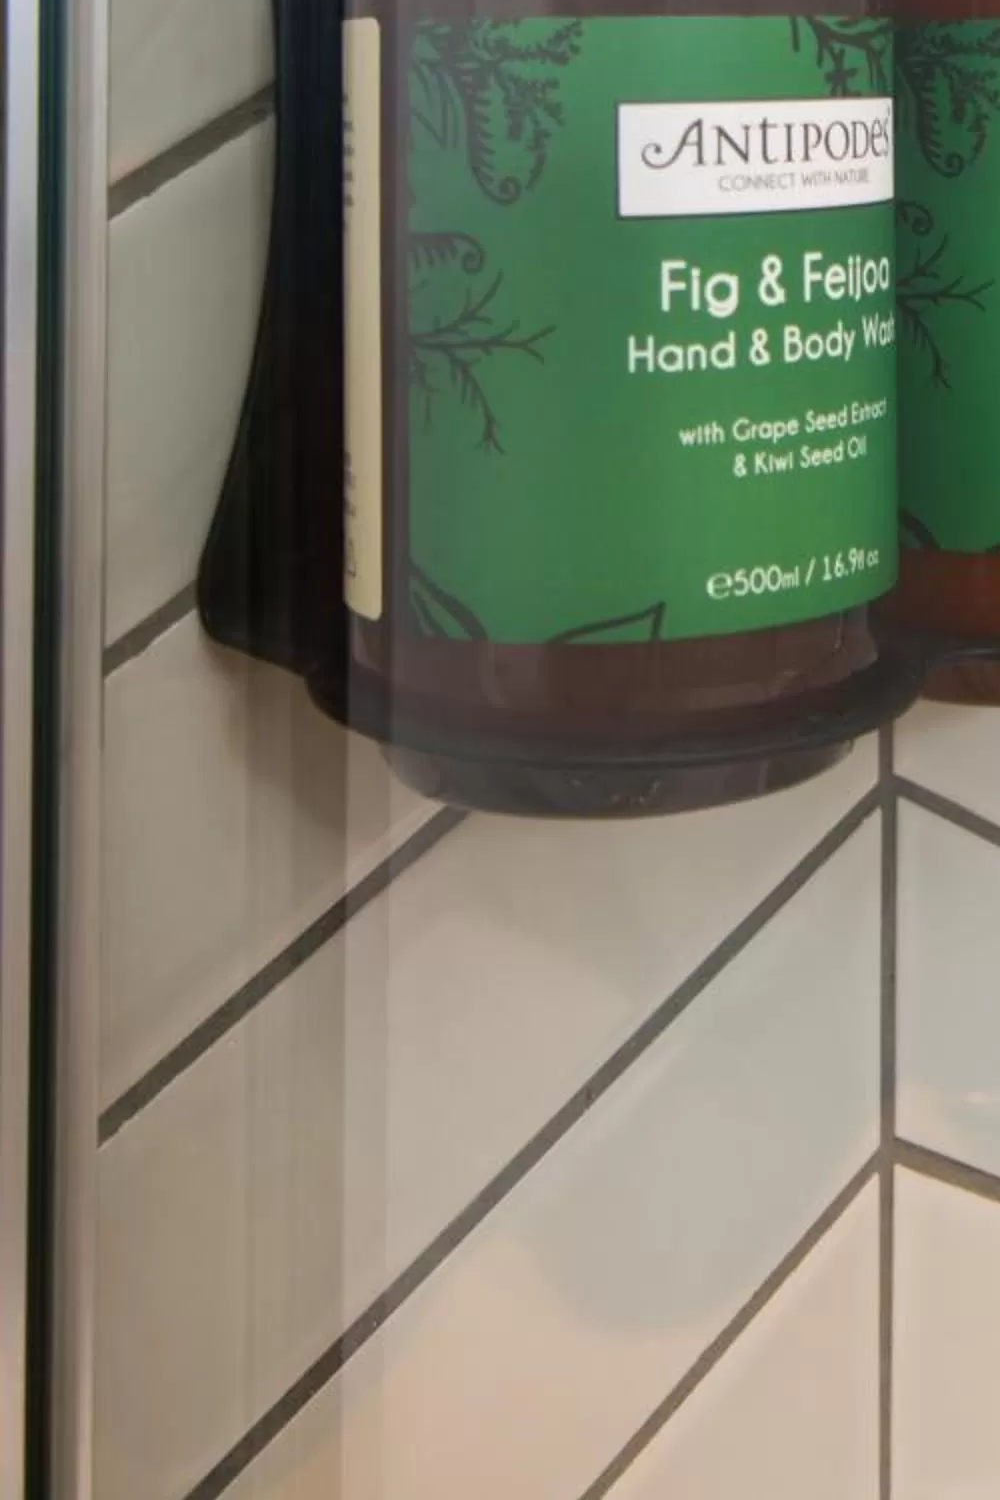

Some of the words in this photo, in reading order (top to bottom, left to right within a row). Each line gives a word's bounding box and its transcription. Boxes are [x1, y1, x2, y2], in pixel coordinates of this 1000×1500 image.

[718, 171, 796, 192] CONNECT
[661, 260, 739, 318] Fig
[758, 254, 786, 305] &
[628, 330, 736, 373] Hand
[749, 328, 772, 365] &
[783, 321, 856, 362] Body
[679, 422, 724, 446] with
[732, 417, 800, 444] Grape
[805, 401, 848, 433] Seed
[733, 453, 747, 477] &
[754, 452, 794, 474] Kiwi
[800, 439, 844, 468] Seed
[804, 557, 816, 586] /
